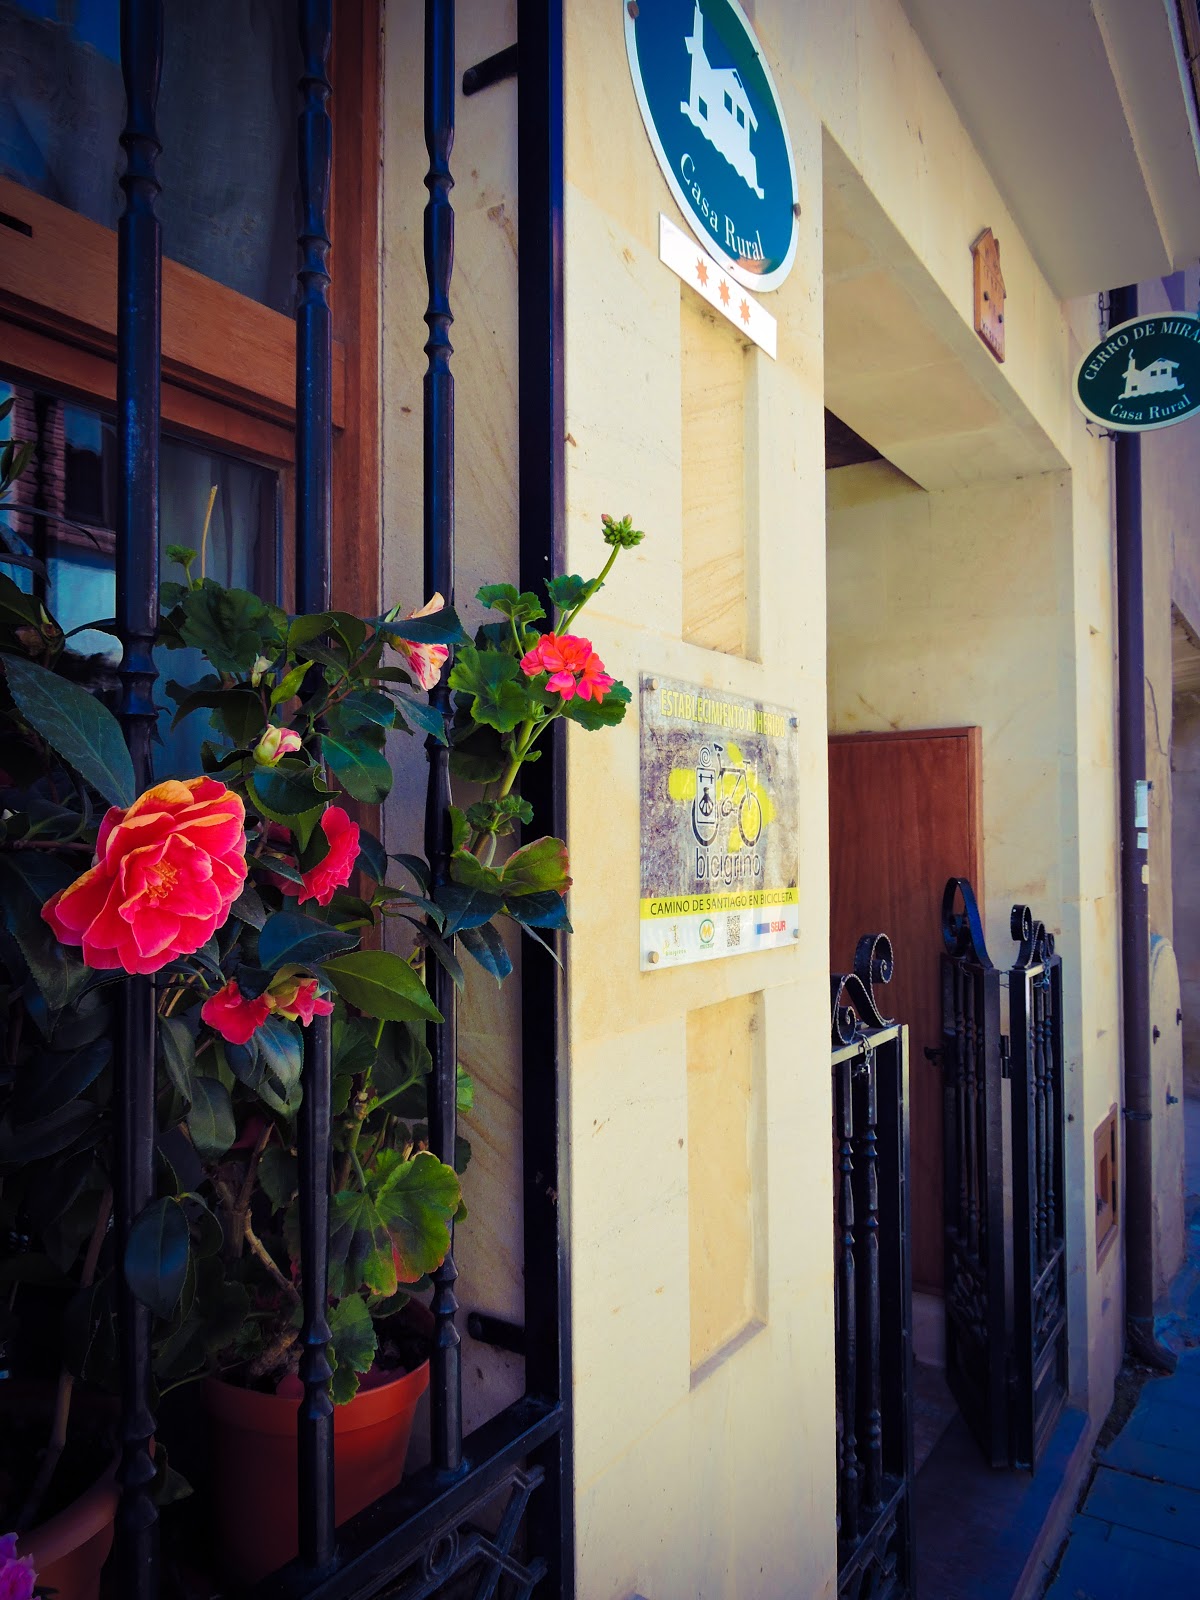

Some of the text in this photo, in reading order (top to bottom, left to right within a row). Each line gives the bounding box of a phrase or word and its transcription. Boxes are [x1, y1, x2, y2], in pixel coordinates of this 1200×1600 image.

[681, 153, 766, 261] Casa Rural
[1084, 321, 1200, 380] CERRO DE MIRA
[1110, 394, 1192, 420] Casa Rural
[661, 688, 785, 738] ESTABLECIMIENTO ADHERIDO
[696, 848, 761, 885] bicigrino
[650, 891, 793, 915] CAMINO DE SANTIAGO EN BICICLETA
[771, 920, 786, 933] SEUR
